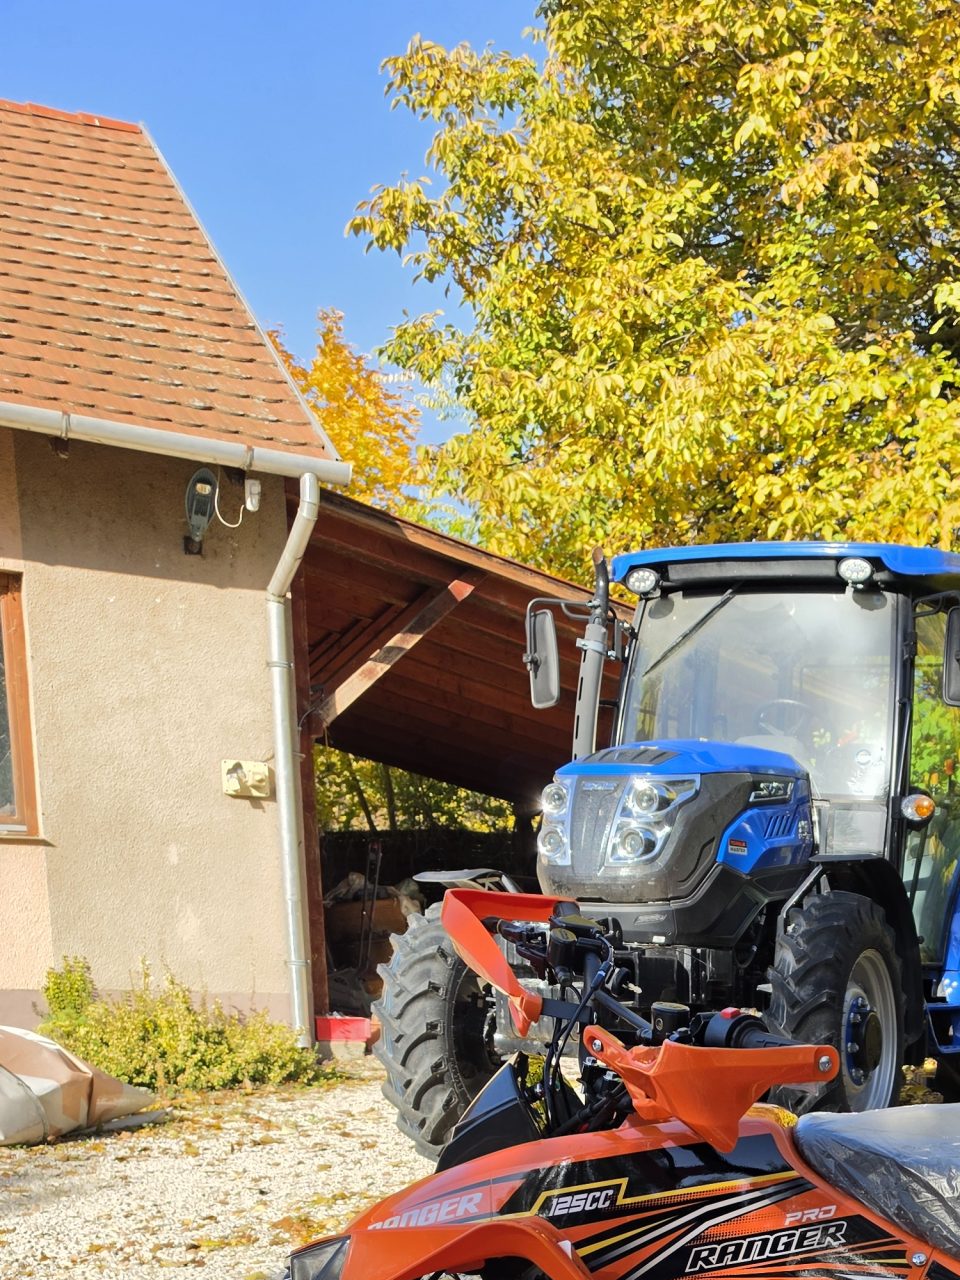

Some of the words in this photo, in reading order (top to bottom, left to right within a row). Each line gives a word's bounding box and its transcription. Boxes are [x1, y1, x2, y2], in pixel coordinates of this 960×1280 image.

[548, 1188, 614, 1217] 125CC
[783, 1204, 838, 1226] PRO
[684, 1221, 848, 1274] RANGER
